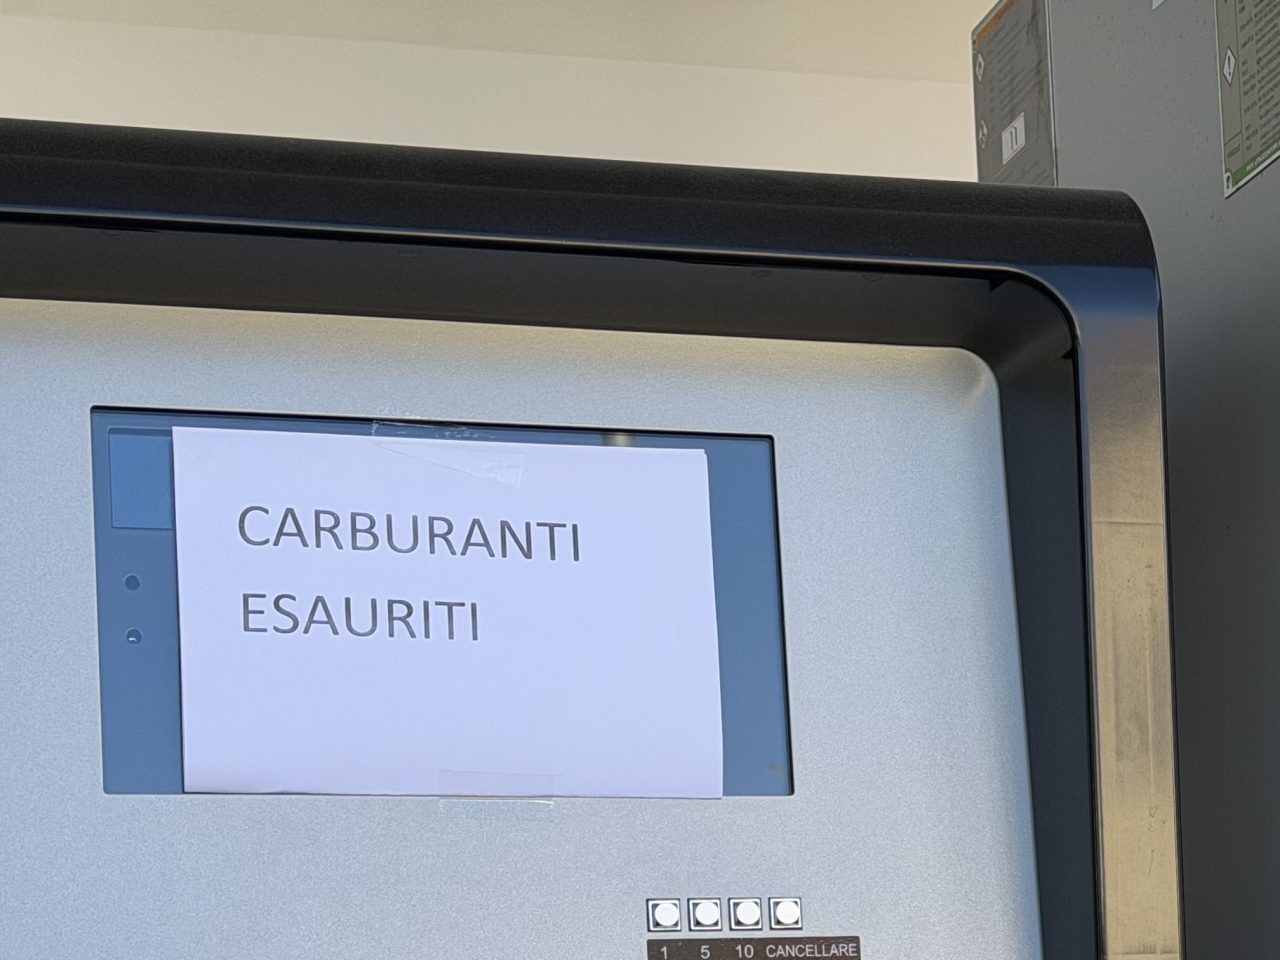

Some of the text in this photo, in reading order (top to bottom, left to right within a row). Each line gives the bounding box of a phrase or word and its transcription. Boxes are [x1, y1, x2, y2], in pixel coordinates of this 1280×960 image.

[237, 504, 582, 562] CARBURANTI
[242, 592, 480, 642] ESAURITI
[660, 946, 668, 960] 1
[701, 945, 711, 958] 5
[735, 945, 754, 958] 10
[766, 944, 857, 958] CANCELLARE
